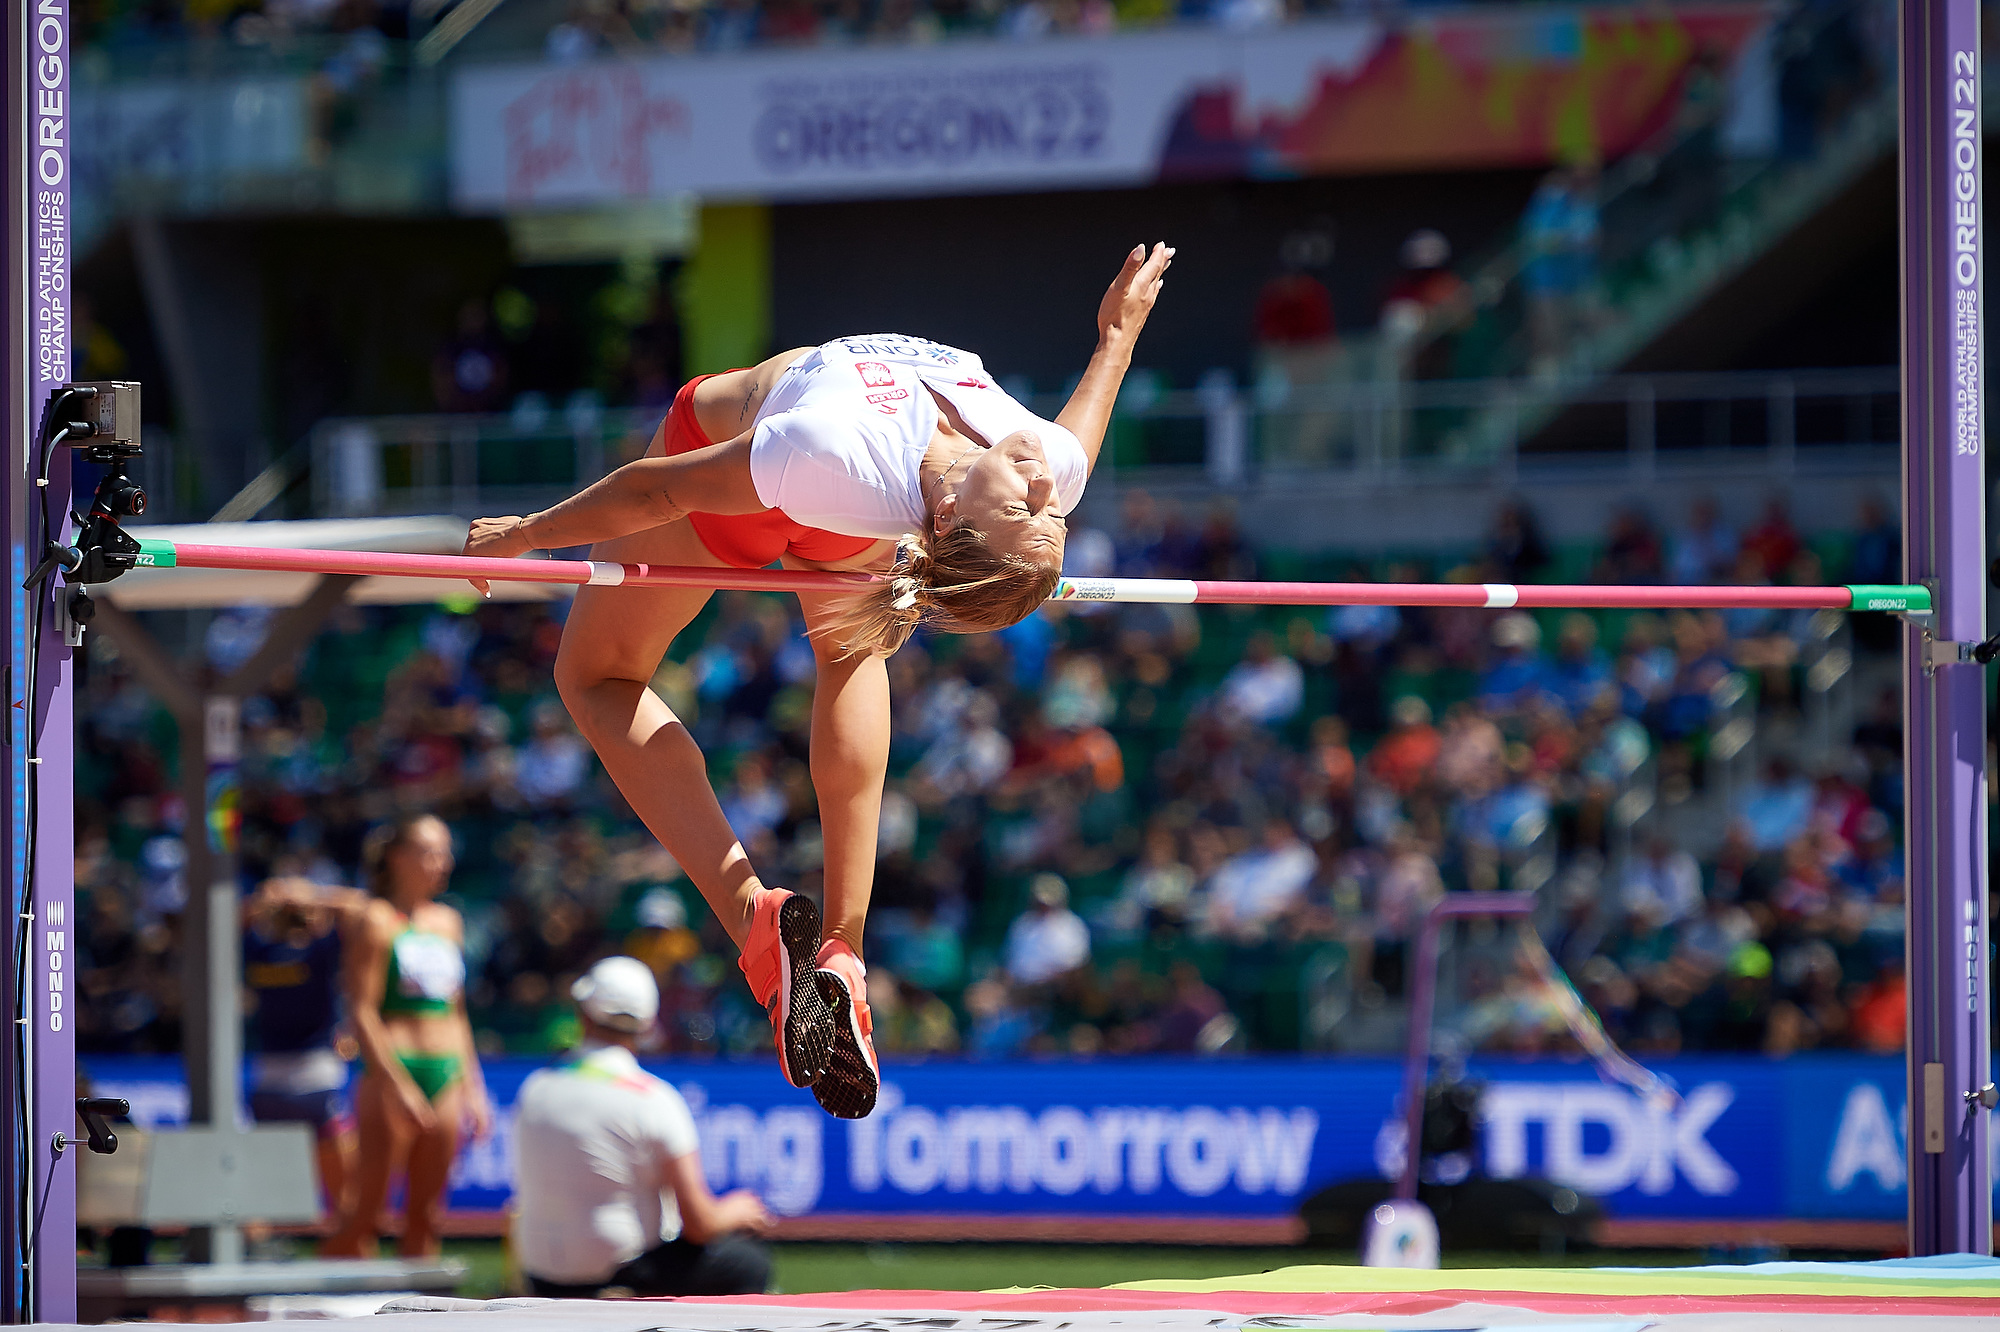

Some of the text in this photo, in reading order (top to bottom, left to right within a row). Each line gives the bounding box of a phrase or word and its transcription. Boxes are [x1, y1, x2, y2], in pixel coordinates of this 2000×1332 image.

[39, 190, 52, 382] WORLD ATHLETICS
[1957, 289, 1968, 456] WORLD ATHLETICS
[1967, 289, 1978, 456] CHAMPIONSHIPS
[46, 931, 65, 1032] MONDO
[846, 1084, 1317, 1196] Tomorrow
[1482, 1081, 1740, 1195] TDK
